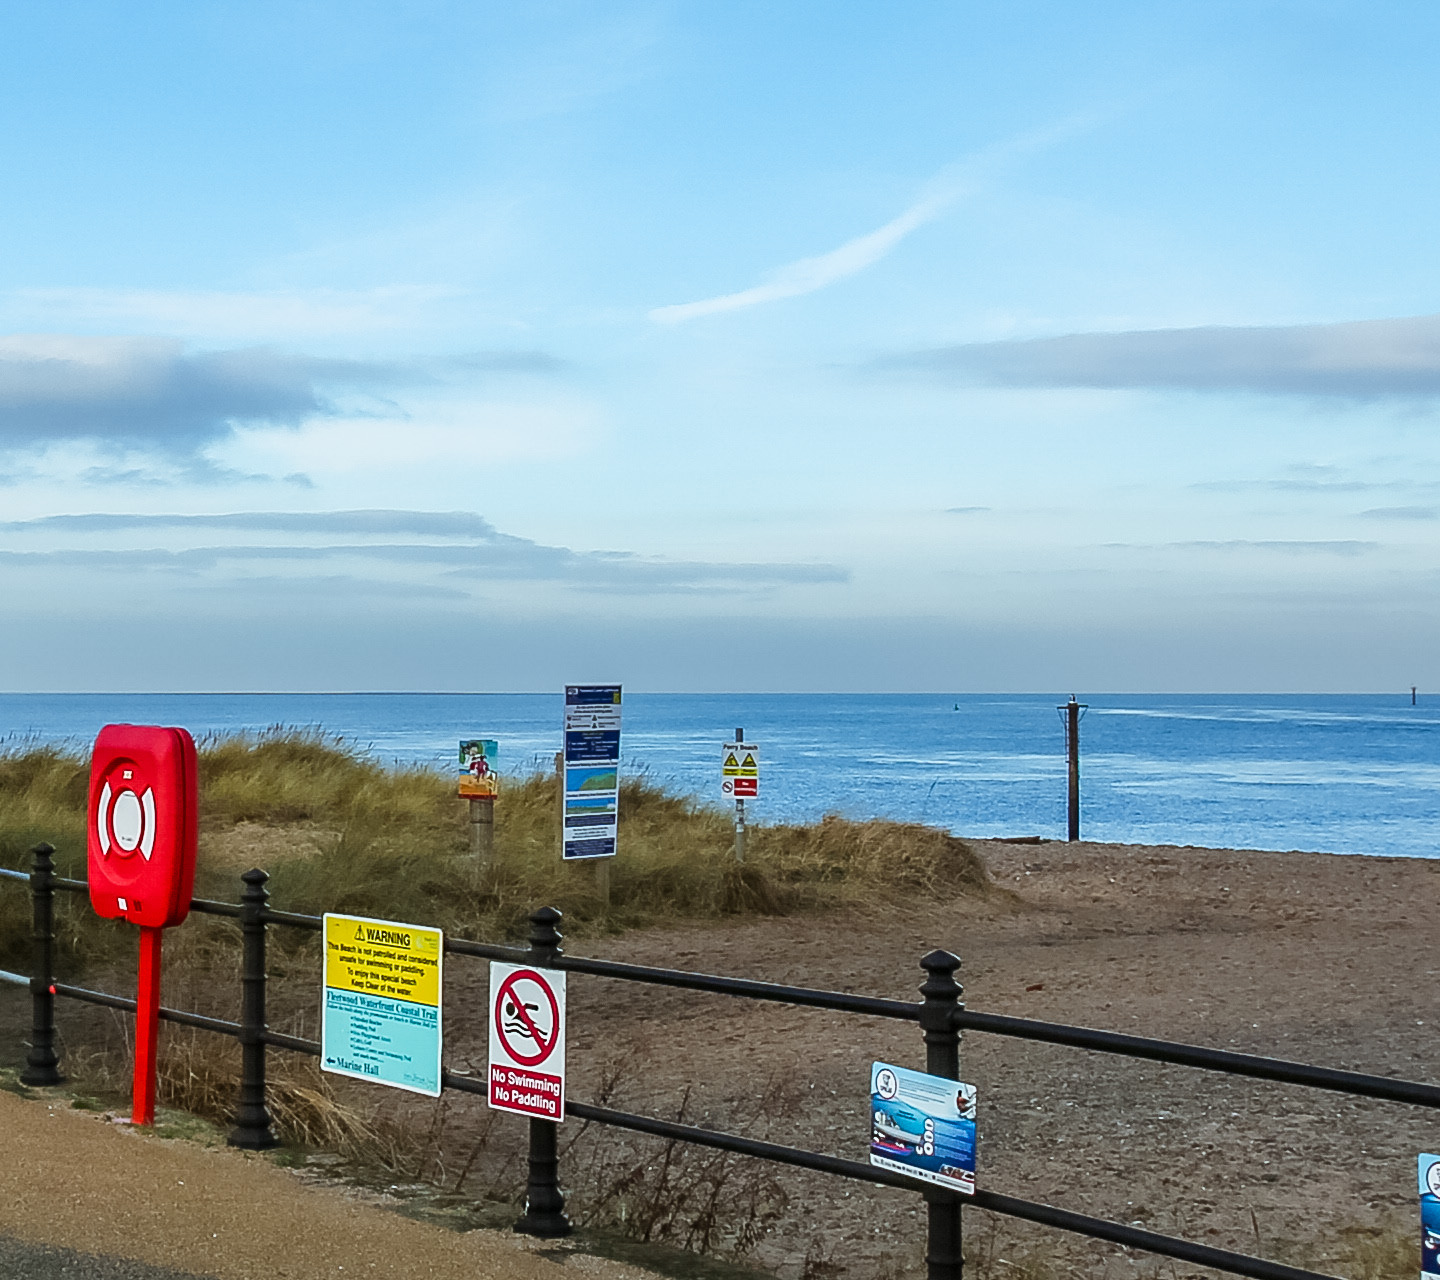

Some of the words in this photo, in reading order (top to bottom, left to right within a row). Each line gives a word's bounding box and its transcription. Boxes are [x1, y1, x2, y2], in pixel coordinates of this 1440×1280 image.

[367, 928, 410, 946] WARNING
[328, 941, 338, 950] This
[341, 944, 356, 952] Beach
[373, 949, 396, 959] patrolled
[397, 953, 407, 961] and
[409, 955, 438, 967] considered
[367, 960, 393, 971] swimming
[347, 967, 353, 975] To
[355, 969, 368, 978] enjoy
[370, 971, 379, 979] this
[381, 973, 399, 983] special
[401, 976, 416, 985] beach
[352, 979, 364, 988] Keep
[366, 981, 379, 989] Clear
[327, 991, 358, 1005] Fleetwood
[359, 996, 394, 1011] Waterfront
[396, 1004, 419, 1016] Coastal
[421, 1008, 437, 1019] Trail
[337, 1057, 362, 1072] Marine
[364, 1063, 379, 1075] Hall
[492, 1068, 506, 1083] No
[508, 1072, 560, 1096] Swimming
[496, 1086, 509, 1101] No
[512, 1090, 556, 1114] Paddling
